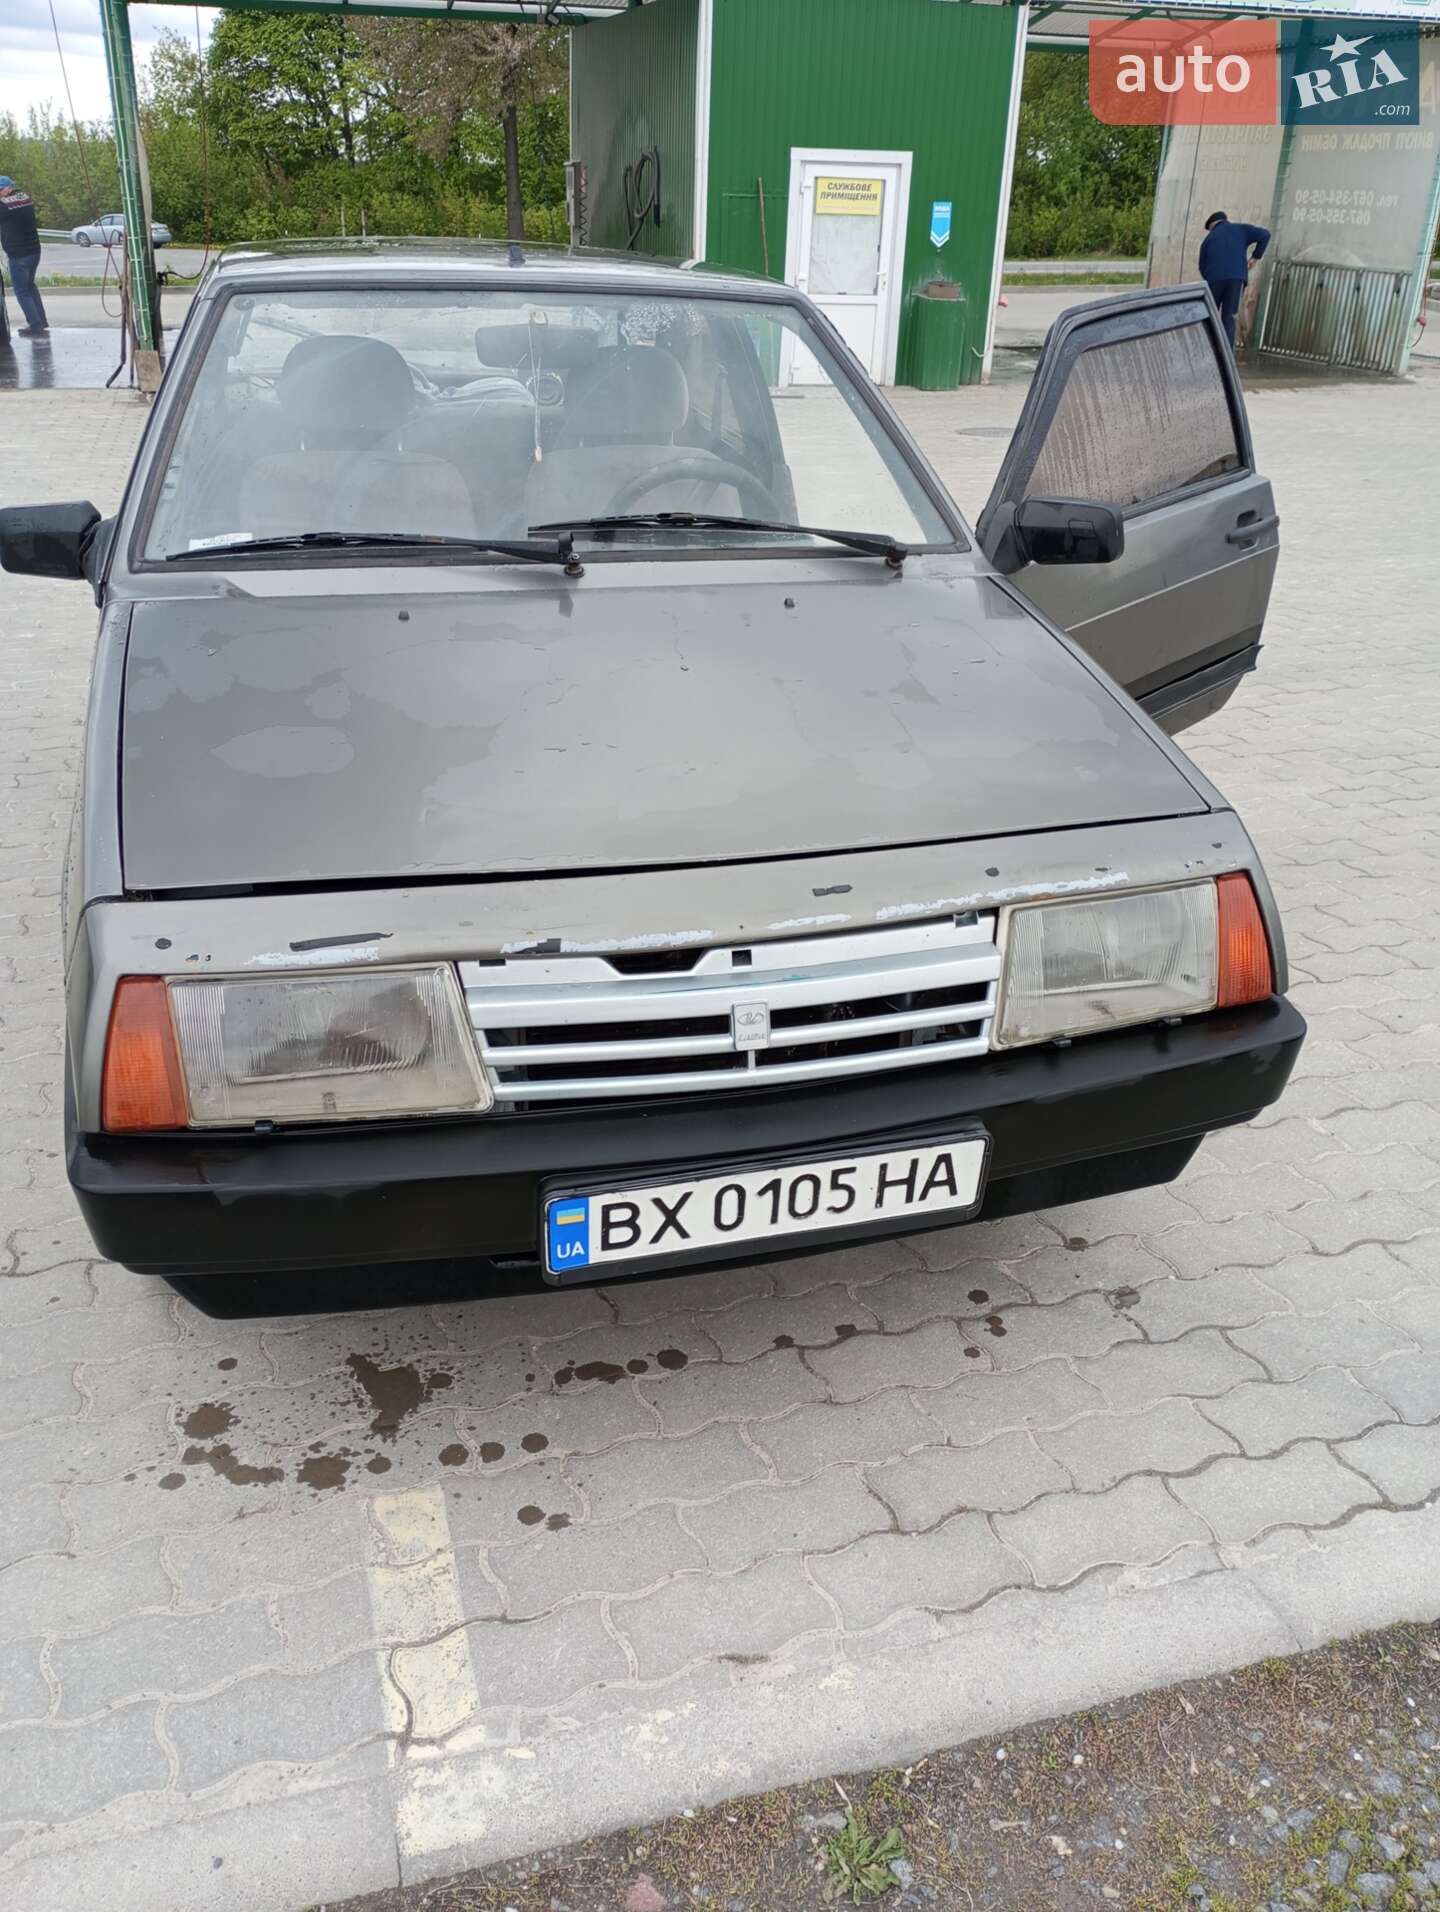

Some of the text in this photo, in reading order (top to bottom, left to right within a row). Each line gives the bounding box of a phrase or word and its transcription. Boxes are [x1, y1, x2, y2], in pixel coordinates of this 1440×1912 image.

[827, 182, 872, 192] СЛУЖБОВЕ
[820, 191, 878, 201] ПРИМІЩЕННЯ
[601, 1152, 959, 1251] BX 0105 HA
[557, 1242, 585, 1259] UA
